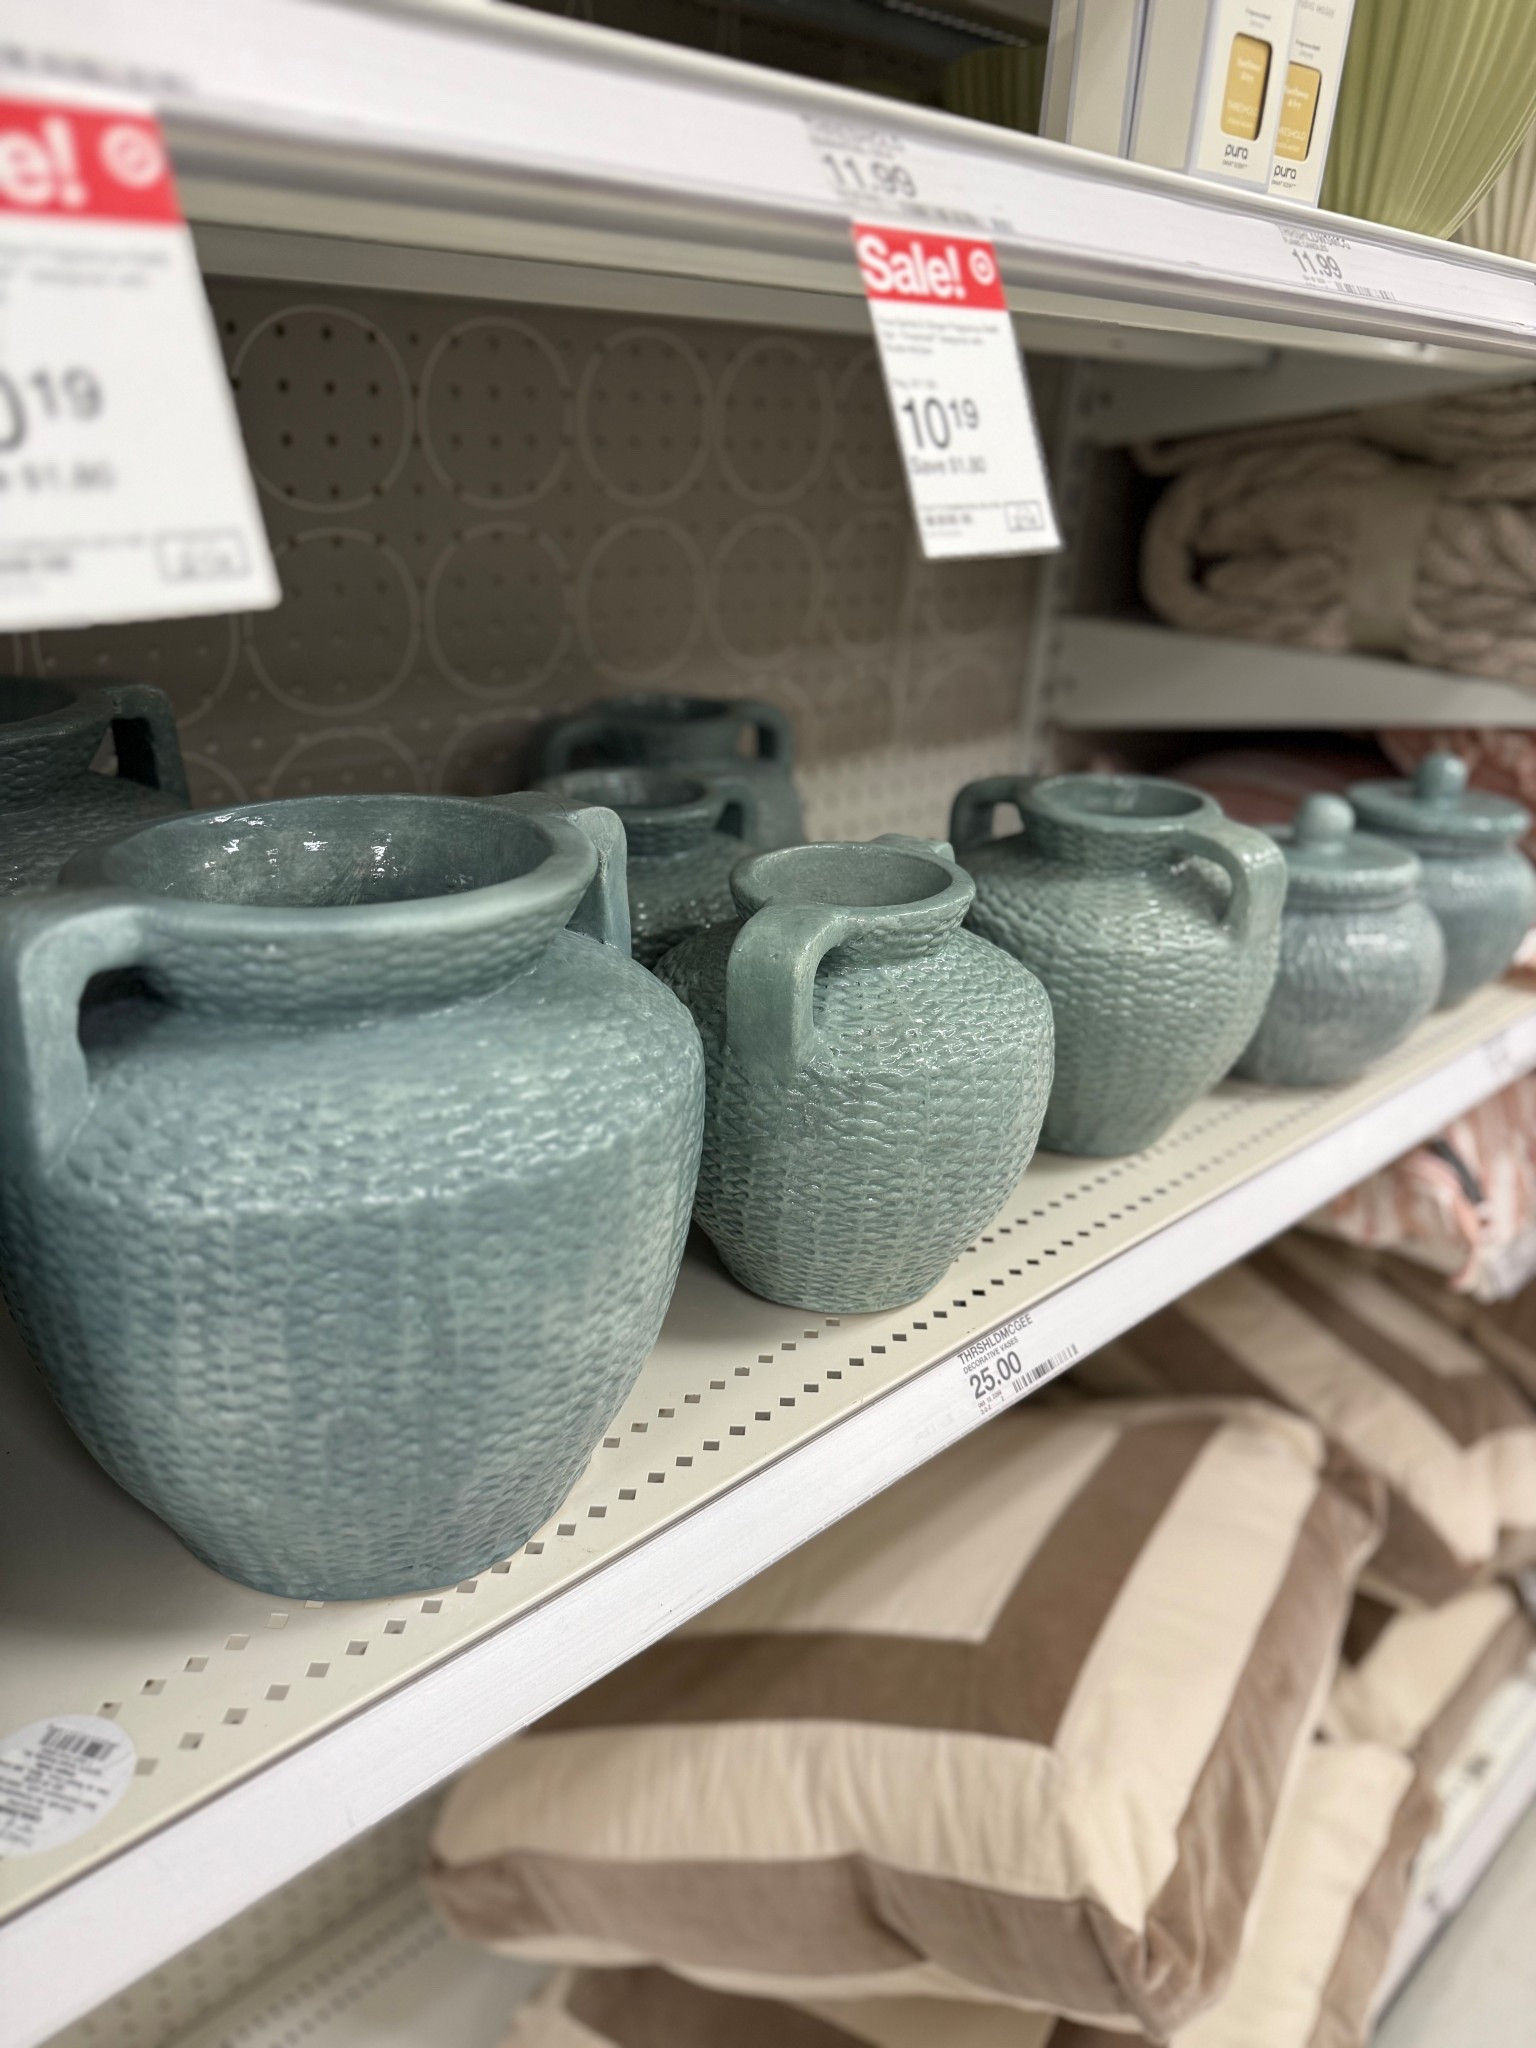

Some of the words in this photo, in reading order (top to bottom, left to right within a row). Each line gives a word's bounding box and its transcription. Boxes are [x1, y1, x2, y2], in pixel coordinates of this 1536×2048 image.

[1224, 143, 1249, 160] pura
[1273, 164, 1297, 180] pura
[822, 154, 917, 198] 11.99
[856, 235, 967, 298] Sale!
[1292, 248, 1343, 279] 11.99
[957, 1313, 1034, 1365] THRSHLDMCGEE
[962, 1348, 1001, 1375] DECORATIVE
[999, 1335, 1020, 1353] VASES
[969, 1350, 1022, 1400] 25.00
